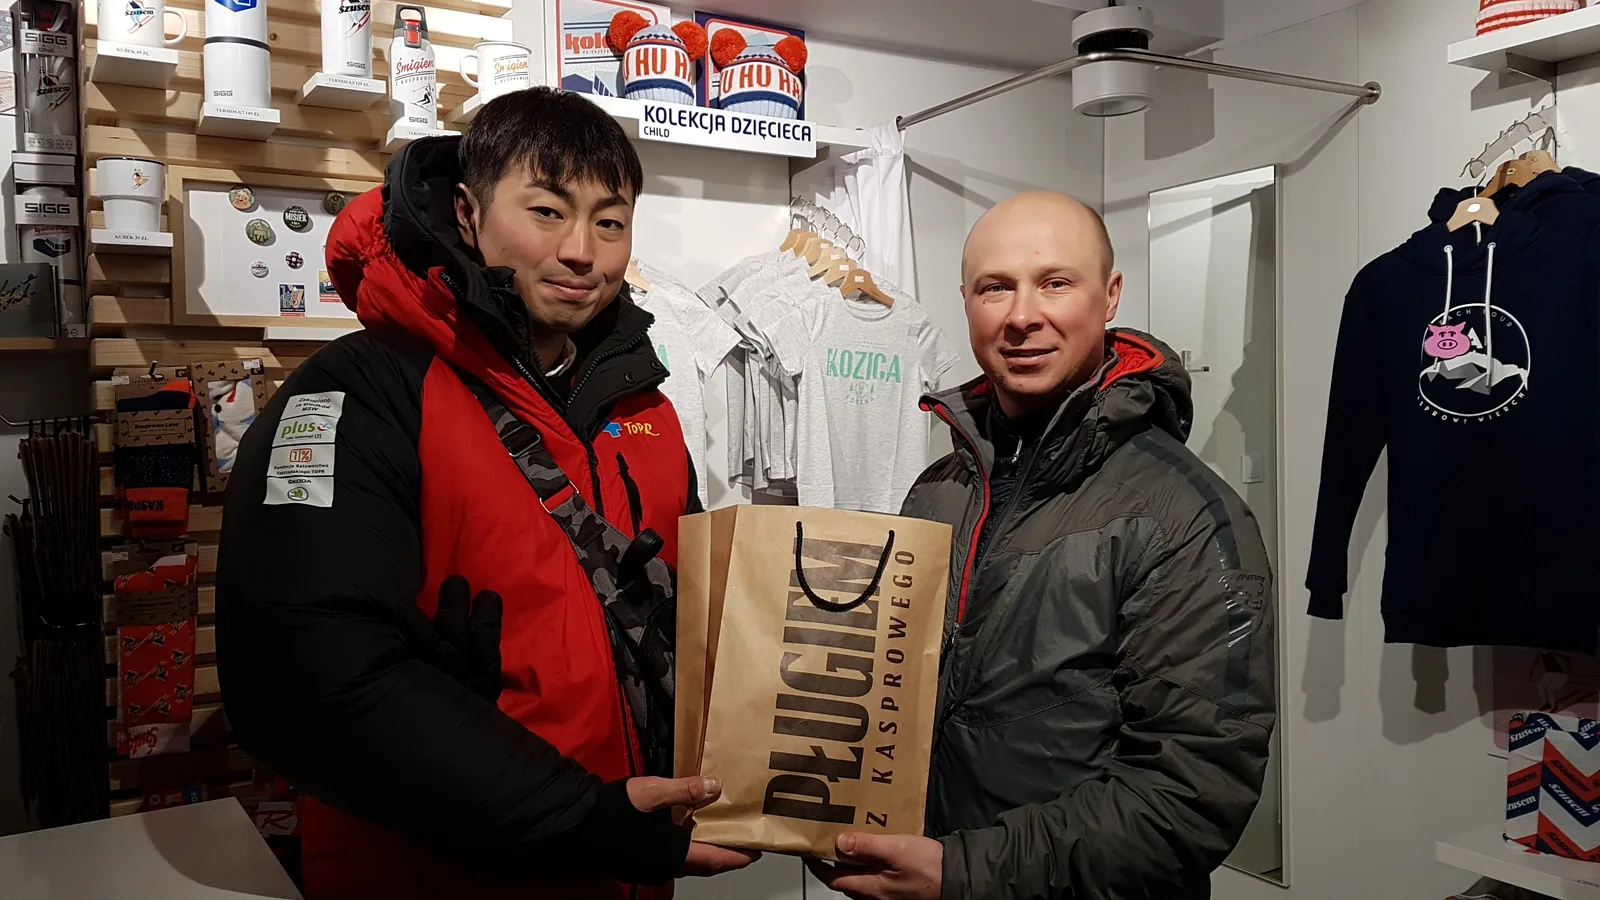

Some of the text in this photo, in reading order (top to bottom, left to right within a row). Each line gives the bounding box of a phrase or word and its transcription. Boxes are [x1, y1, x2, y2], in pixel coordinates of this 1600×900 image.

[25, 33, 68, 46] SIGG
[346, 61, 366, 70] SIGG
[636, 47, 668, 77] HU
[740, 64, 772, 89] HU
[643, 125, 670, 138] CHILD
[644, 104, 812, 142] KOLEKCJA DZIĘCIECA
[25, 203, 70, 214] SIGG
[826, 347, 901, 383] KOZICA
[281, 420, 316, 439] plus
[624, 421, 660, 437] TOPR
[293, 450, 310, 461] 1%
[762, 537, 887, 825] PŁUGIEM
[866, 550, 915, 828] Z KASPROWEGO
